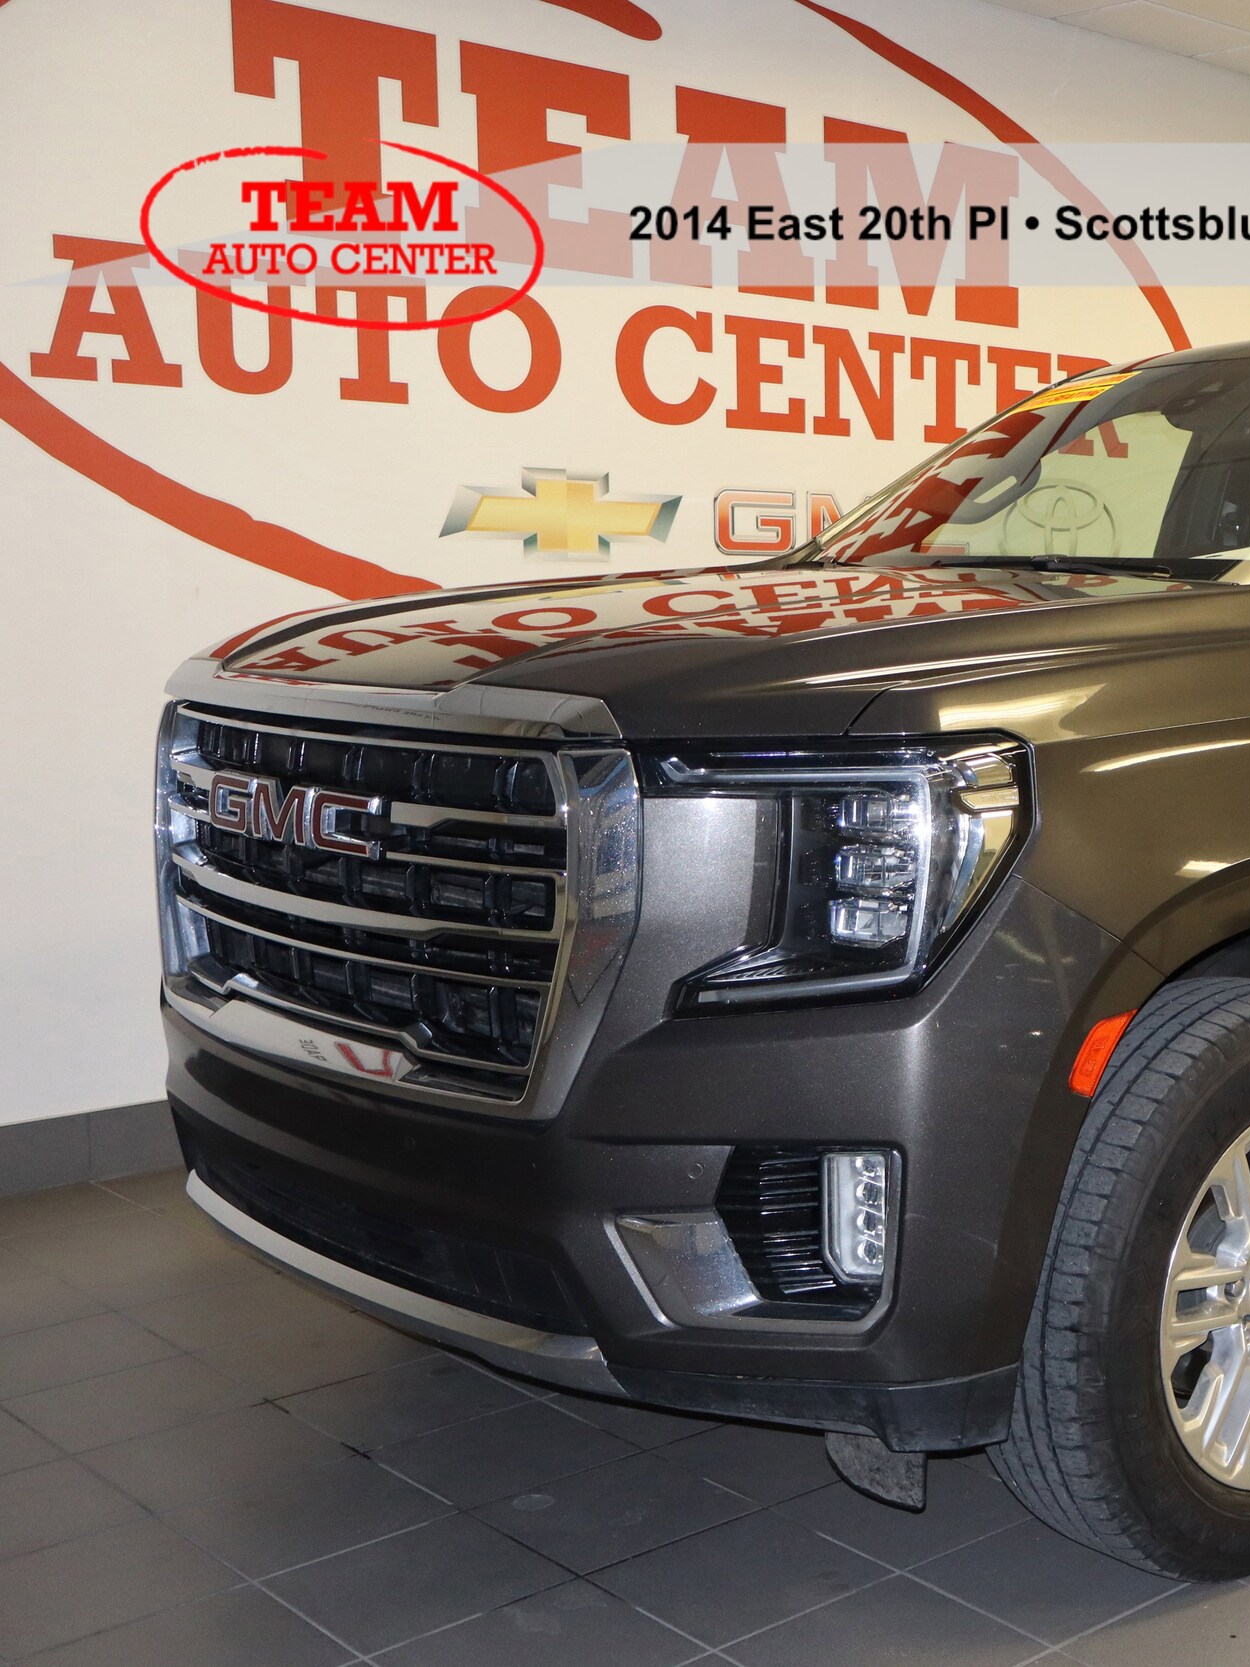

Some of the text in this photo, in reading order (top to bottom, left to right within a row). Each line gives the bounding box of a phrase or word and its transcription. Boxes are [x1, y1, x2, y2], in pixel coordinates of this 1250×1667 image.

[230, 0, 1019, 329] TEAM
[30, 234, 562, 414] AUTO
[210, 768, 387, 861] GMC
